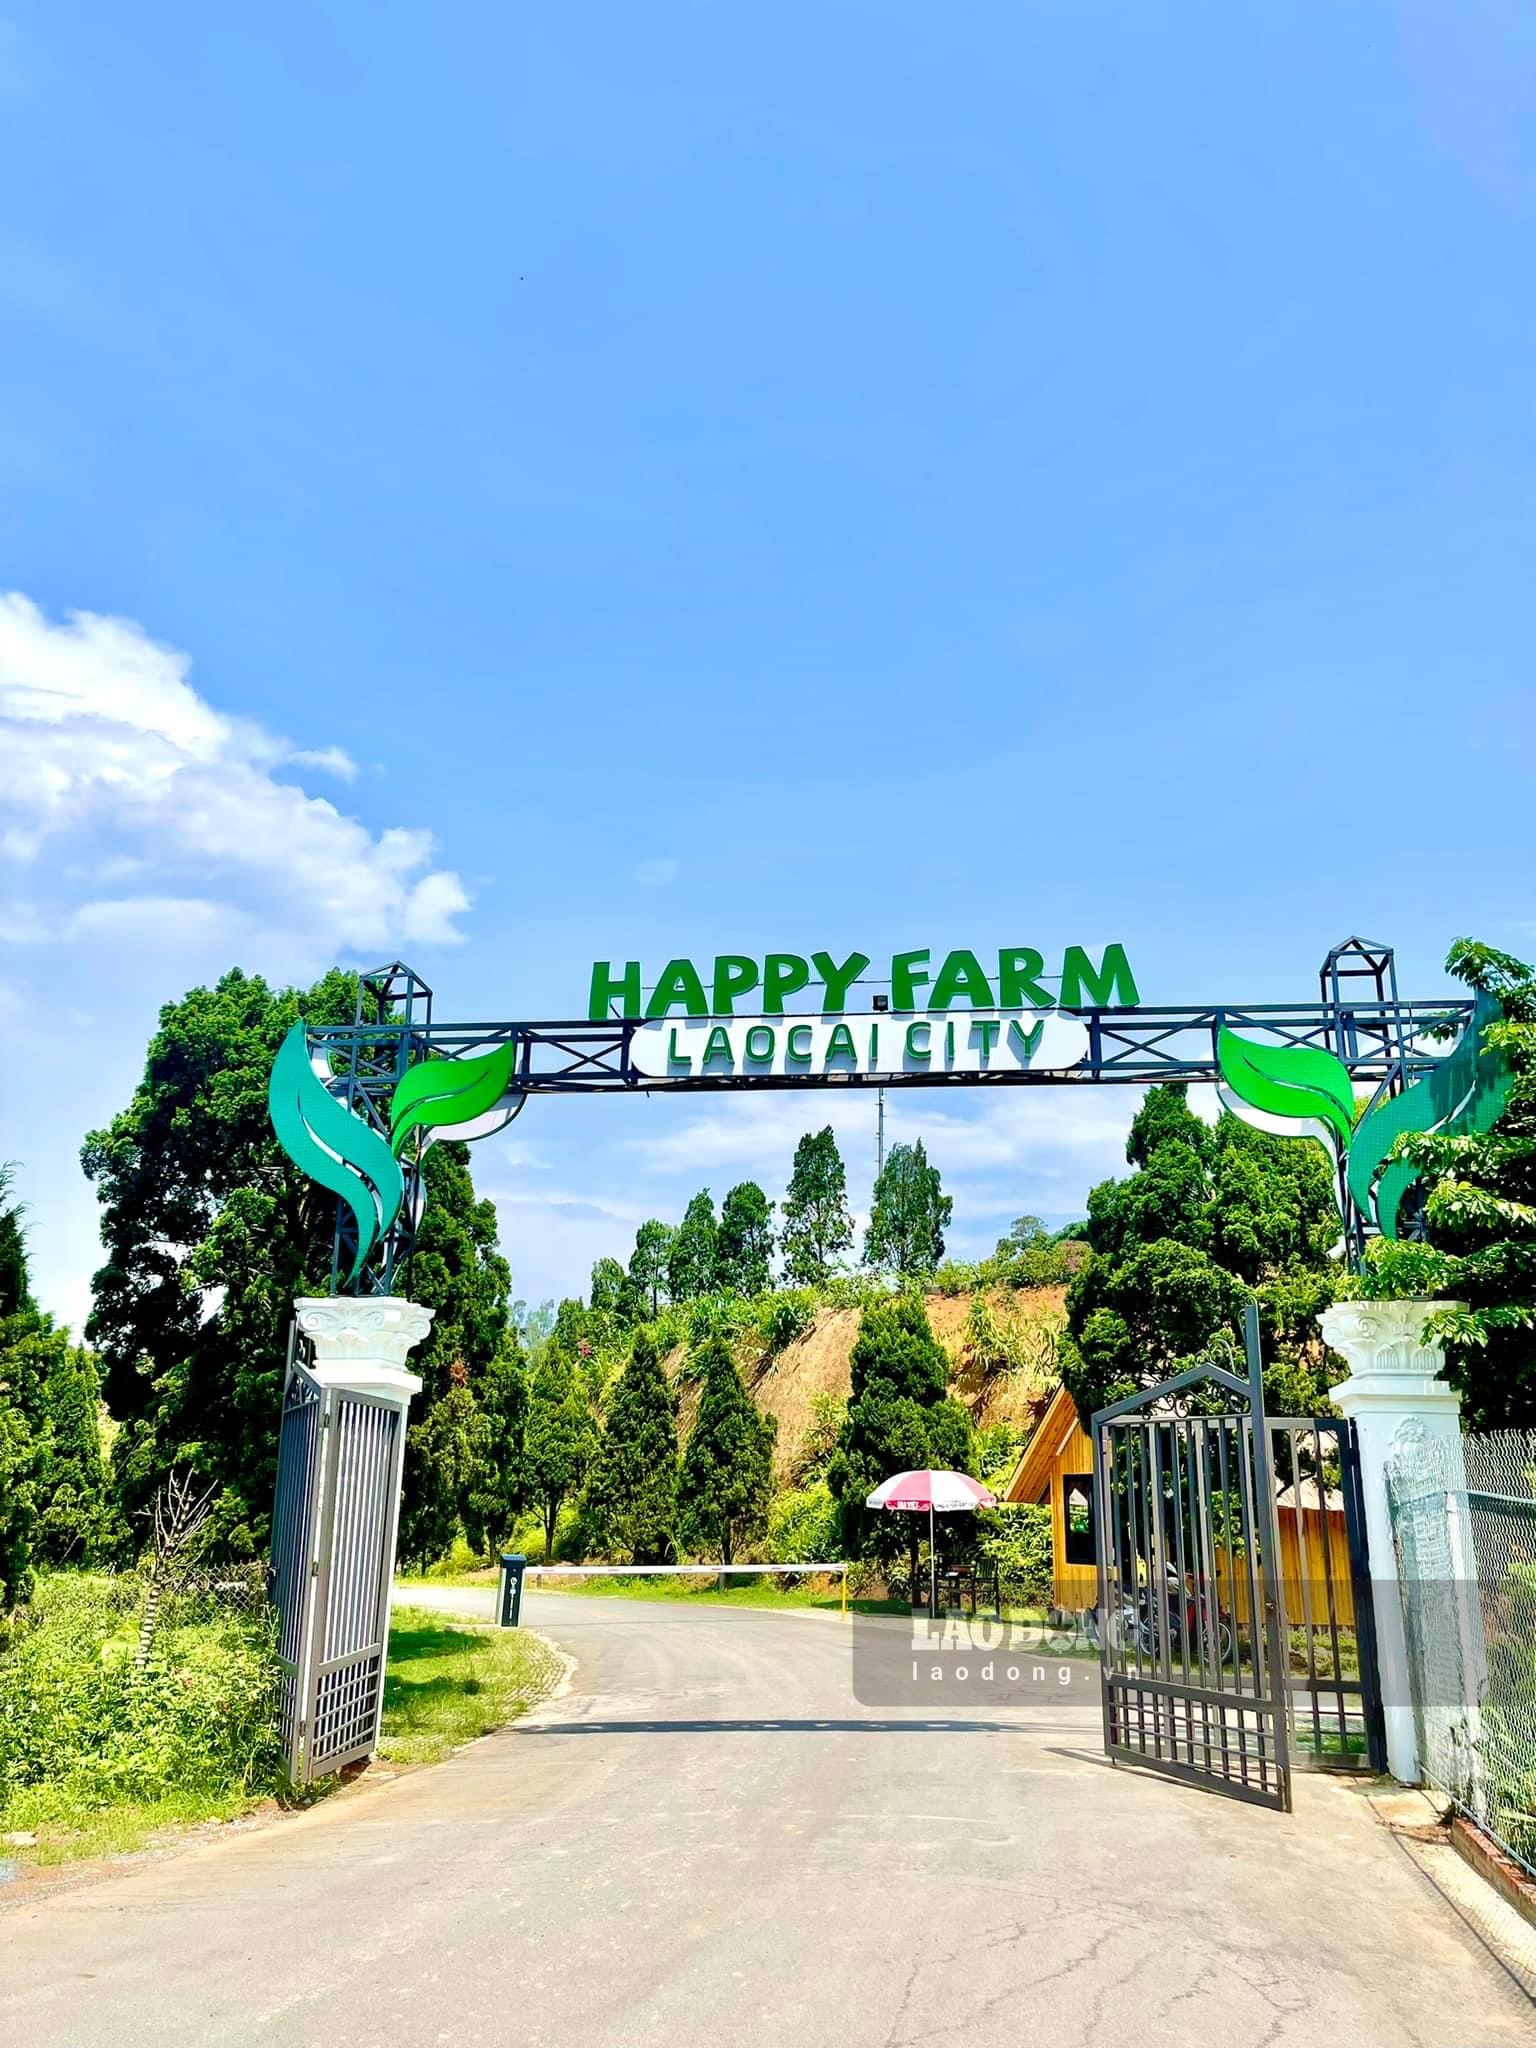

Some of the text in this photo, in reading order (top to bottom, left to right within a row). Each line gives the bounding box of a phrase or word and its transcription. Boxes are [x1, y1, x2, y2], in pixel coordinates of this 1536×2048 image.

[589, 943, 1141, 1020] HAPPY FARM
[905, 1019, 1046, 1060] CITY
